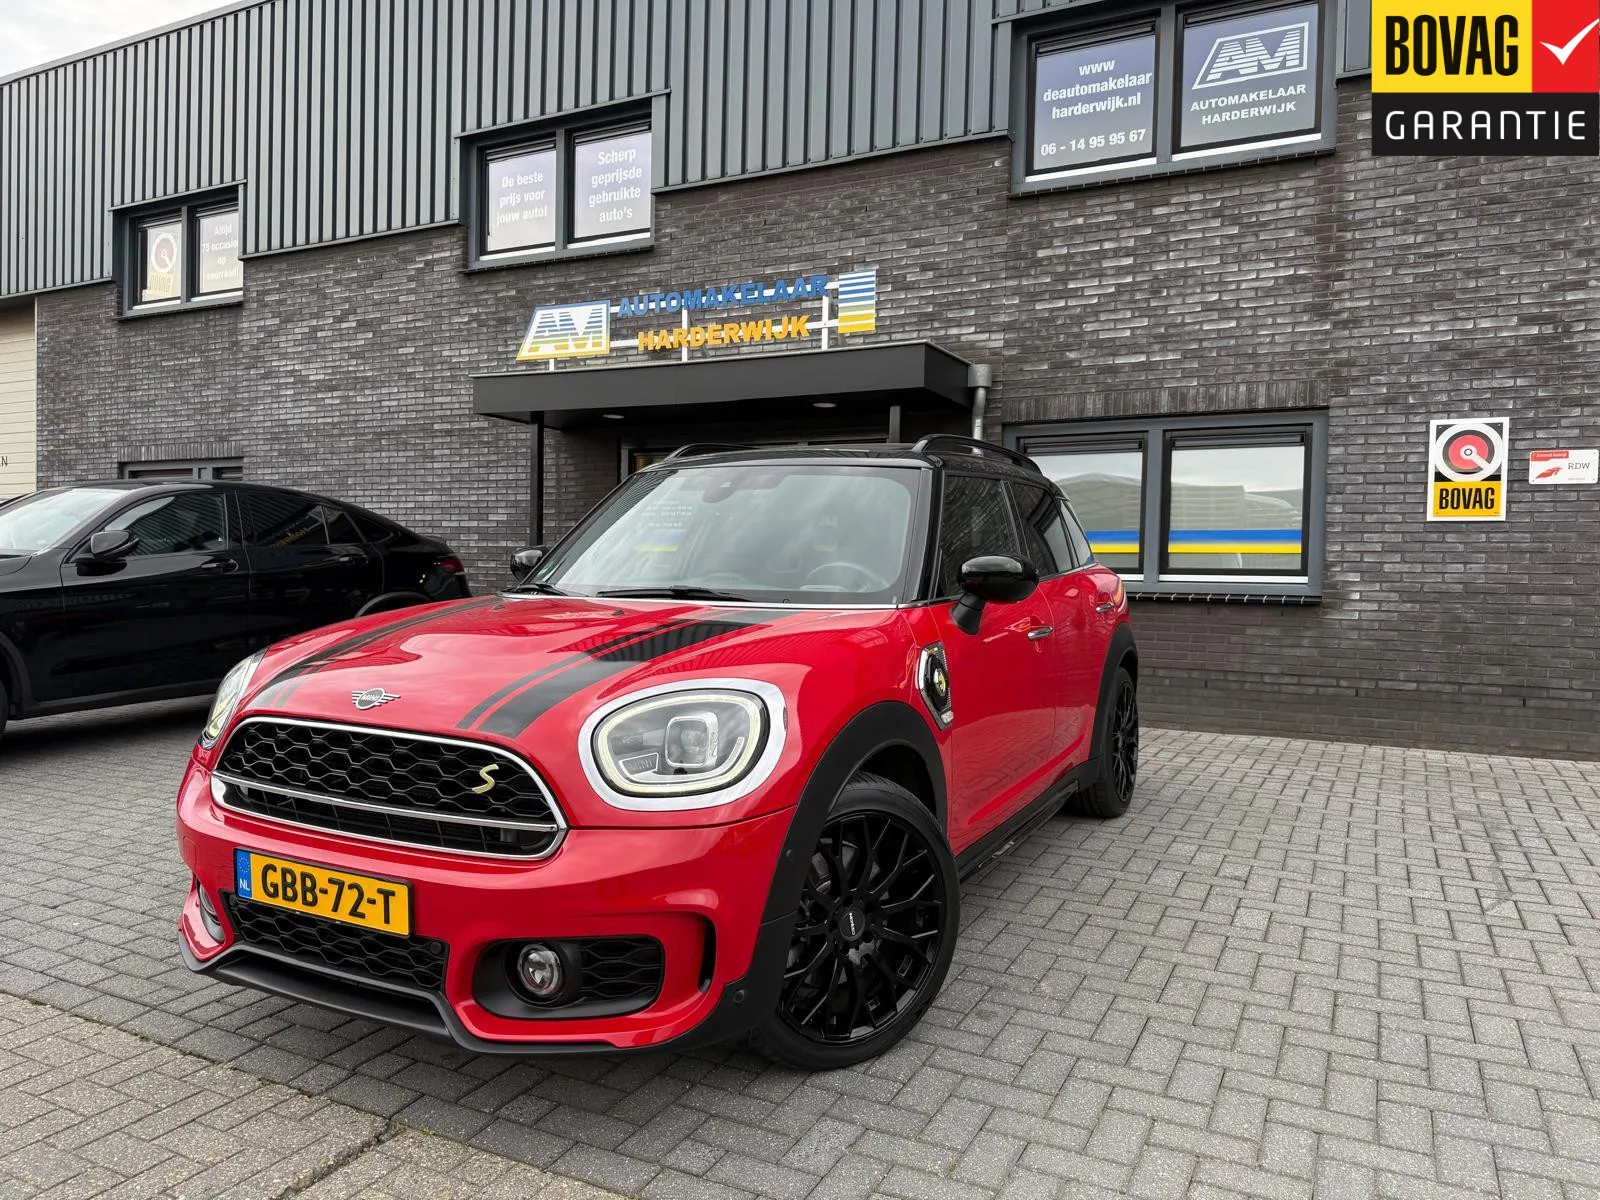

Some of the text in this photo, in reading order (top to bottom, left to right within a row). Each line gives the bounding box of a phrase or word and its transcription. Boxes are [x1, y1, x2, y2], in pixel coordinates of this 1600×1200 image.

[1079, 60, 1116, 76] www
[1043, 72, 1152, 102] deautomakelaar
[1190, 84, 1306, 111] AUTOMAKELAAR
[1052, 92, 1141, 119] harderwijk.nl
[1202, 101, 1296, 125] HARDERWIJK
[1040, 143, 1057, 156] 06
[1070, 138, 1086, 152] 14
[1089, 135, 1105, 149] 95
[1109, 132, 1126, 146] 95
[1129, 129, 1146, 143] 67
[597, 149, 636, 165] Scherp
[502, 171, 544, 188] De beste
[591, 166, 642, 188] geprijsde
[499, 190, 546, 209] prijs voor
[588, 185, 641, 208] gebruikte
[496, 204, 548, 227] jouw auto!
[599, 206, 633, 223] auto's
[211, 237, 239, 251] occasio
[617, 275, 829, 318] AUTOMAKELAAR
[638, 314, 810, 352] HARDERWIJK
[1567, 462, 1591, 470] RDW
[1438, 487, 1495, 510] BOVAG
[471, 763, 499, 794] S
[239, 878, 250, 891] NL
[261, 863, 396, 925] GBB-72-T
